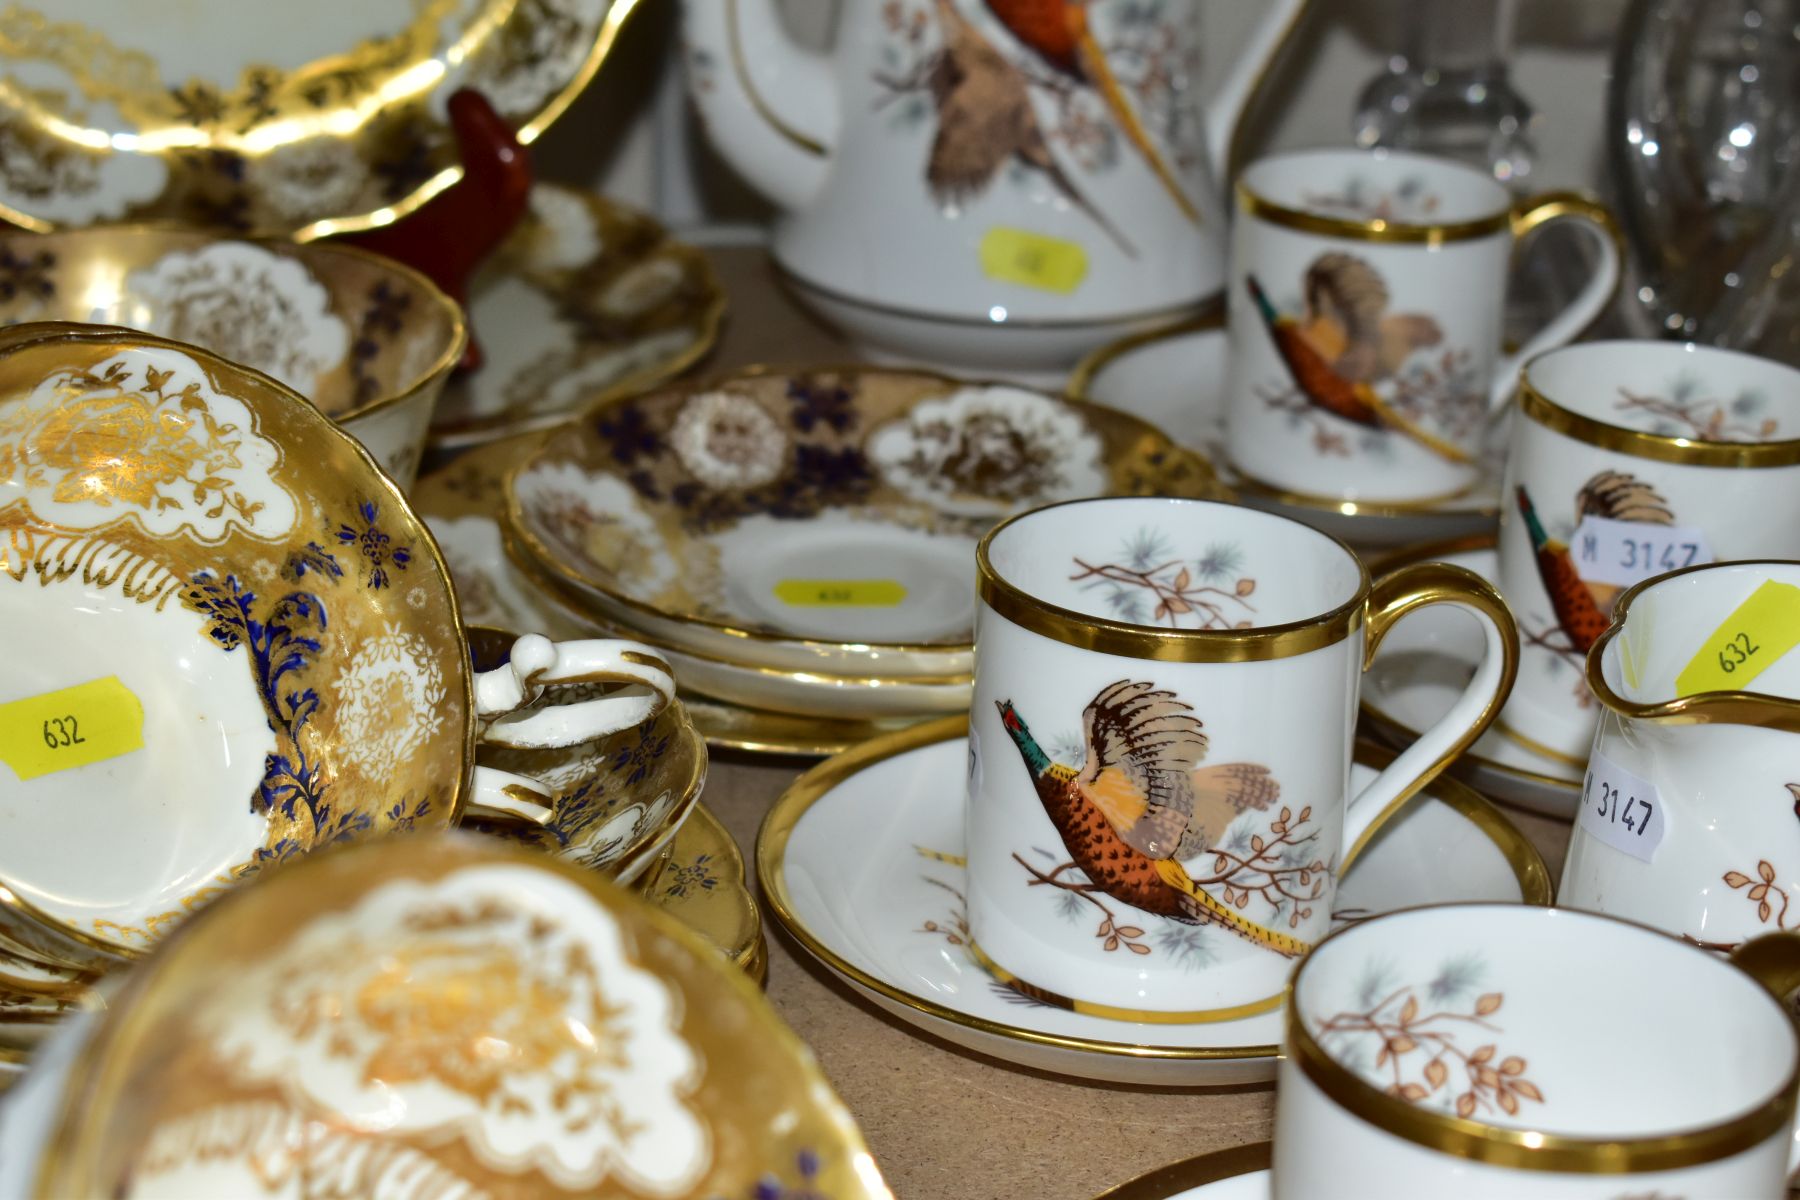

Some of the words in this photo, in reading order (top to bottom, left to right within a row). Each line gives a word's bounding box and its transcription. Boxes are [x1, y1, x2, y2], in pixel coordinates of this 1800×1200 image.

[1620, 538, 1698, 571] 3147
[1719, 632, 1760, 674] 632
[44, 715, 86, 750] 632
[1597, 781, 1653, 836] 3147
